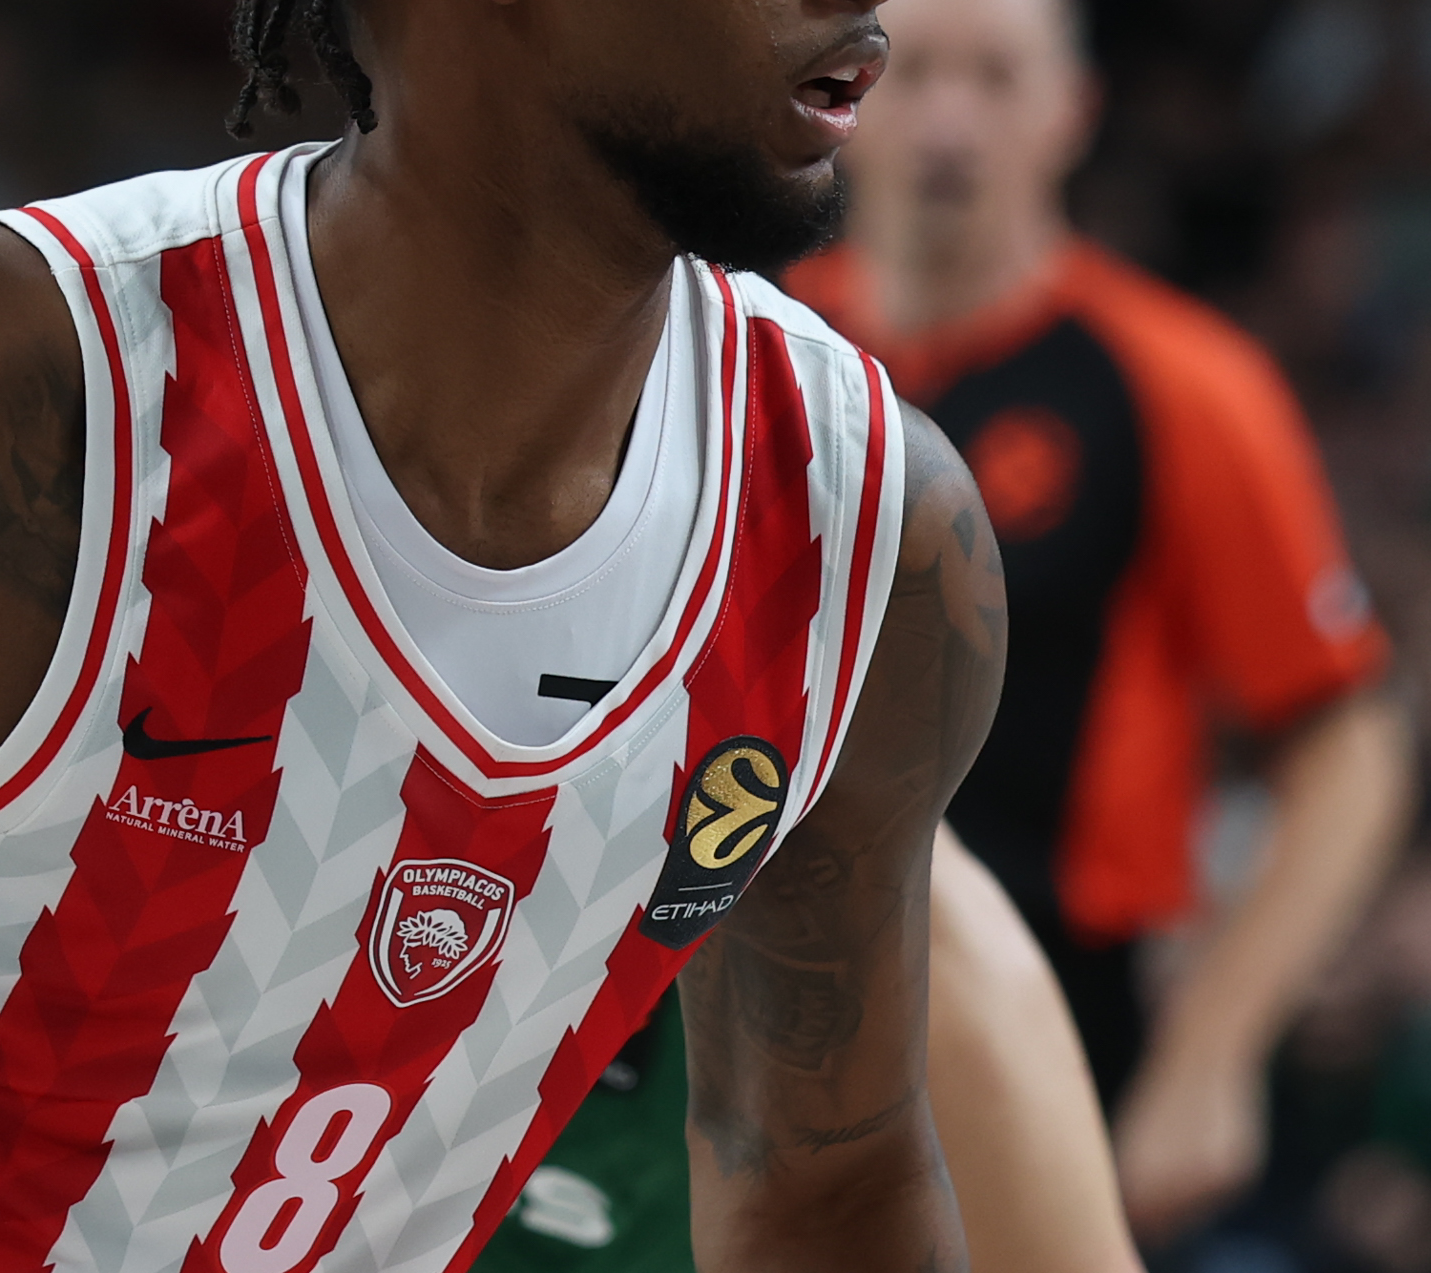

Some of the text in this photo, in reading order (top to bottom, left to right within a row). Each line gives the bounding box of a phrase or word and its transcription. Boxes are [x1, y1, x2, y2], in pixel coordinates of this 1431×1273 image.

[106, 812, 245, 853] NATURAL MINERAL WATER
[403, 868, 505, 901] OLYMPIACOS
[412, 885, 485, 910] BASKETBALL
[651, 895, 734, 920] ETIHAD
[431, 958, 452, 969] 1925
